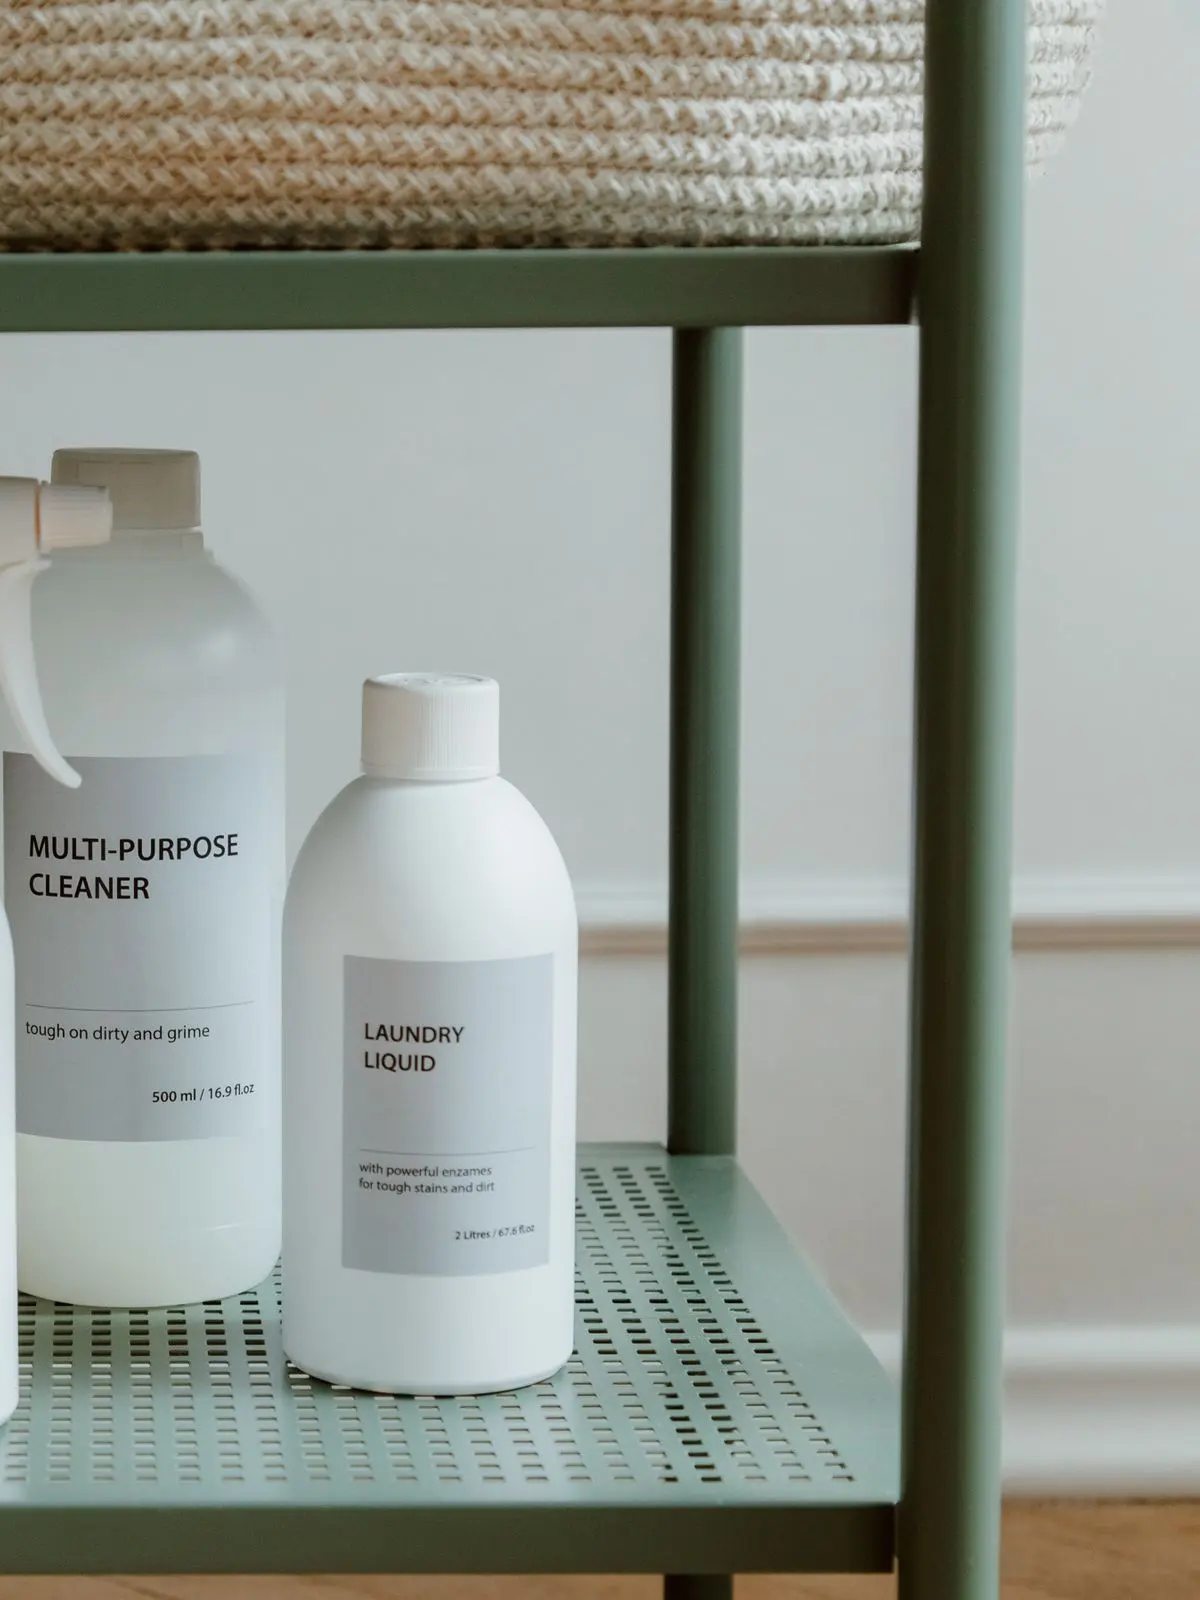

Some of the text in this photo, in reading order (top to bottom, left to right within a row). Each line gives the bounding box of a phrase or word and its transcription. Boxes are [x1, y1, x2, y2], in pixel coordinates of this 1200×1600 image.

[29, 834, 238, 861] MULTI-PURPOSE
[29, 873, 150, 899] CLEANER
[26, 1022, 210, 1044] tough on dirty and grime
[365, 1023, 465, 1044] LAUNDRY
[365, 1052, 436, 1072] LIQUID
[152, 1091, 177, 1103] 500
[180, 1089, 196, 1101] ml
[208, 1085, 231, 1099] 16.9
[234, 1082, 255, 1096] fl.oz
[359, 1163, 383, 1175] with
[387, 1165, 439, 1177] powerful
[359, 1179, 495, 1194] for tough stains and dirt
[455, 1231, 461, 1240] 2
[463, 1229, 491, 1240] Litres
